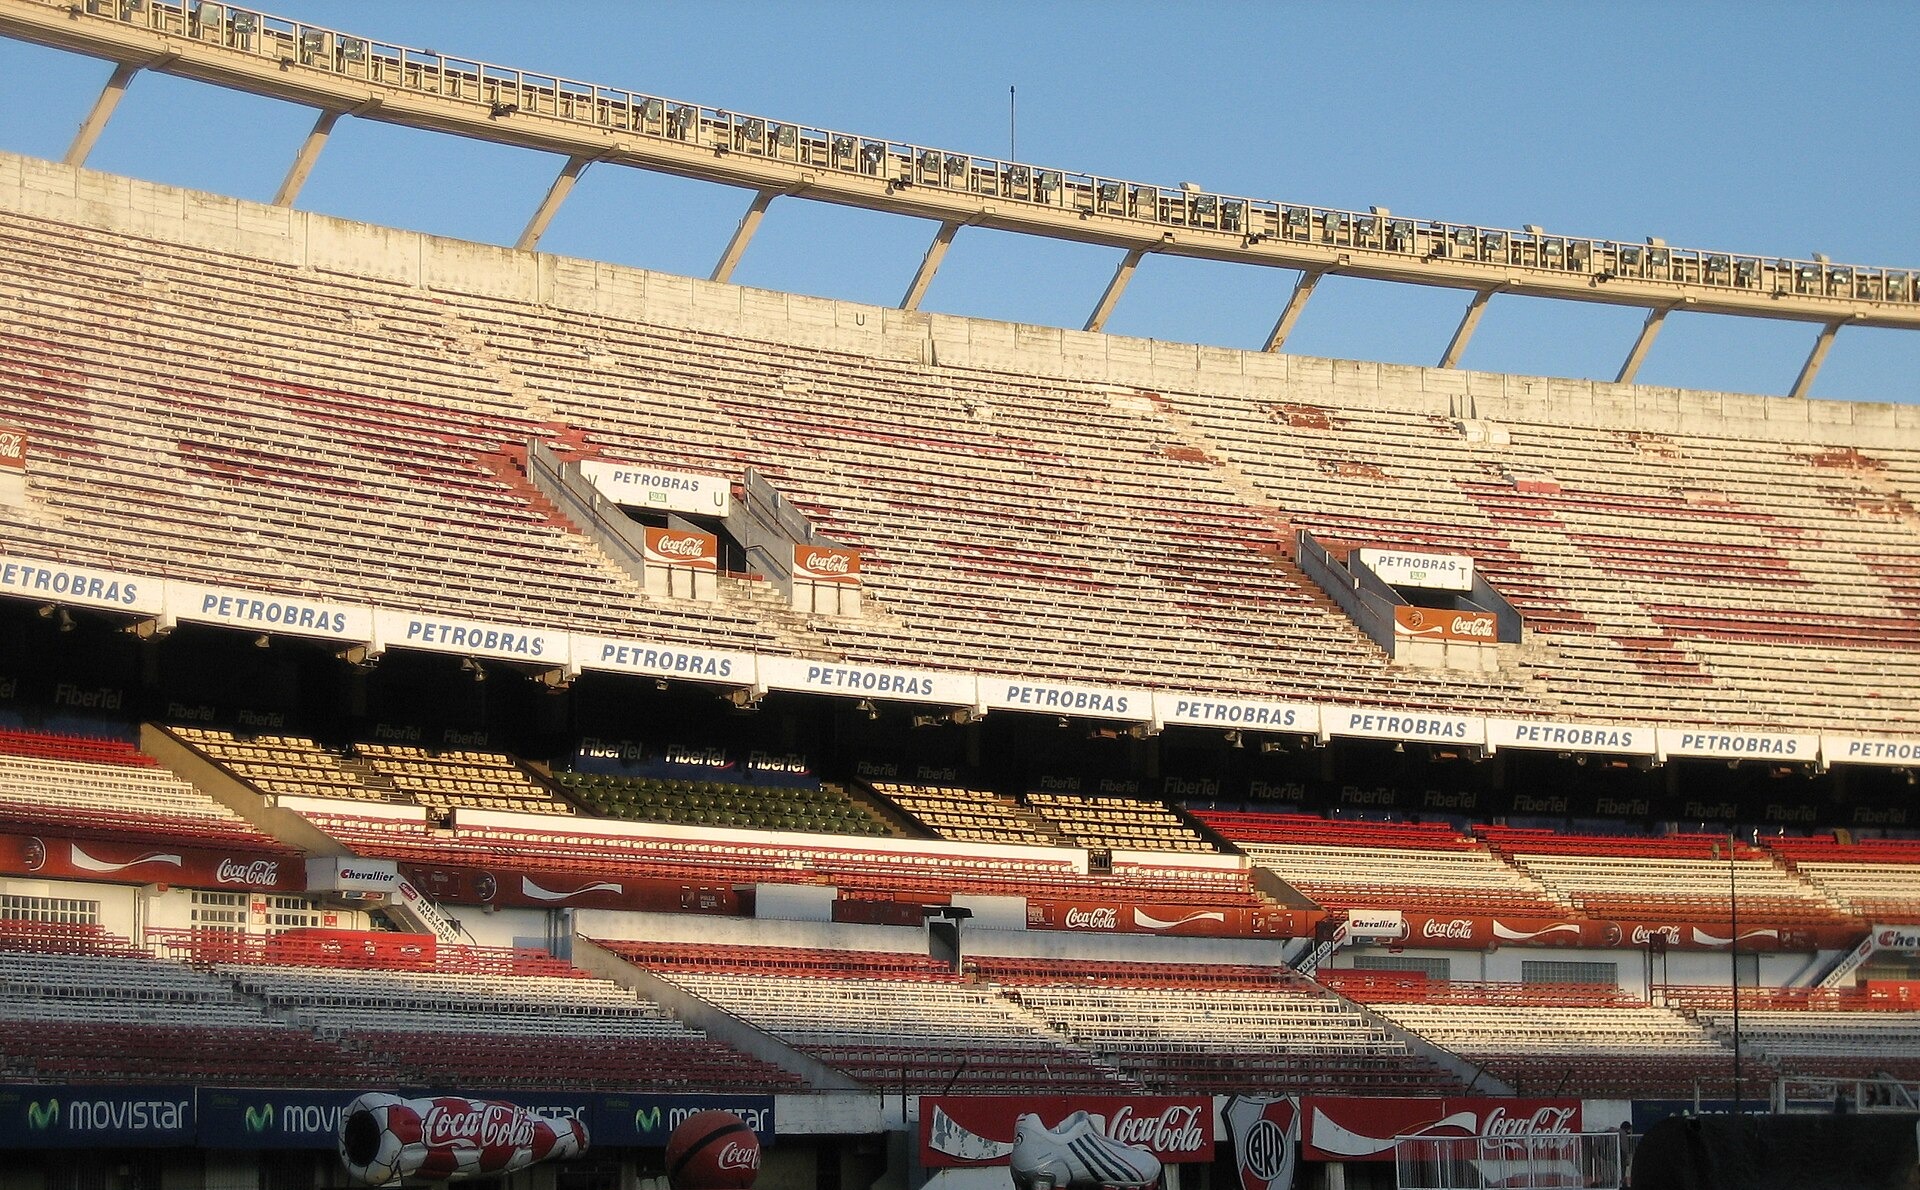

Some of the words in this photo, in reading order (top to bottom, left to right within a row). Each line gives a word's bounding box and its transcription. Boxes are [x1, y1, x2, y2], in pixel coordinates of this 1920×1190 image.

[856, 313, 865, 326] U
[613, 471, 699, 492] PETROBRAS
[714, 492, 723, 507] U
[657, 535, 703, 557] Coca-Cola
[806, 552, 849, 573] Coca-Cola
[1379, 556, 1456, 571] PETROBRAS
[1459, 567, 1467, 580] T
[0, 562, 138, 605] ETROBRAS
[202, 594, 346, 633] PETROBRAS
[1452, 617, 1494, 636] Coca-Cola
[407, 621, 544, 657] PETROBRAS
[602, 643, 732, 678] PETROBRAS
[807, 666, 934, 697] PETROBRAS
[1007, 686, 1129, 714] PETROBRAS
[1176, 700, 1296, 727] PETROBRAS
[1350, 713, 1467, 738] PETROBRAS
[1515, 725, 1633, 748] PETROBRAS
[579, 737, 643, 760] FiberTel
[664, 744, 727, 767] FiberTel
[1681, 734, 1797, 755] PETROBRAS
[747, 750, 807, 773] FiberTel
[216, 858, 278, 886] Coca-Cola
[340, 868, 394, 882] Chevallier
[1065, 907, 1117, 928] Coca-Cola
[1352, 919, 1398, 931] Chevallier
[1423, 918, 1473, 939] Coca-Cola
[420, 1105, 534, 1149] Coca-Cola
[1108, 1105, 1207, 1152] Coca-Cola
[1482, 1106, 1577, 1150] Coca-Cola
